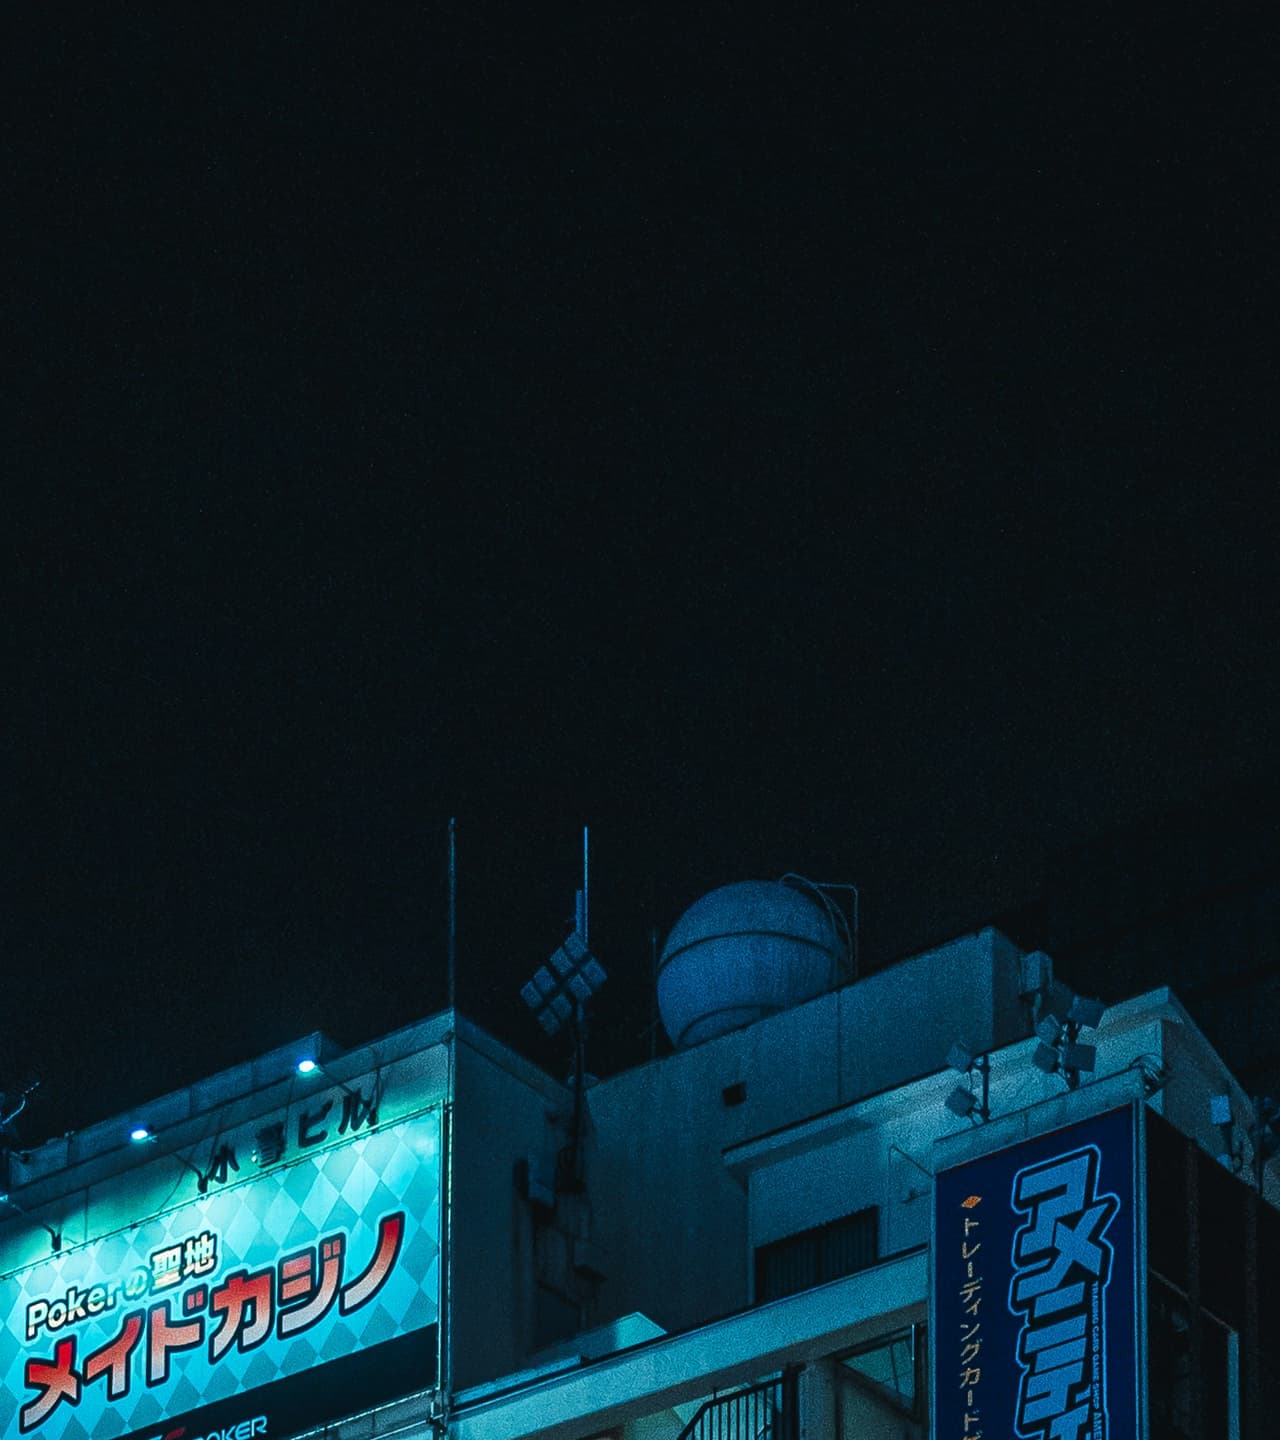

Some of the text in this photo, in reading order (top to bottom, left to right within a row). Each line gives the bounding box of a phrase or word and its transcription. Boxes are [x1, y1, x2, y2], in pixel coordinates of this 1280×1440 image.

[21, 1211, 405, 1433] メイドカジノ
